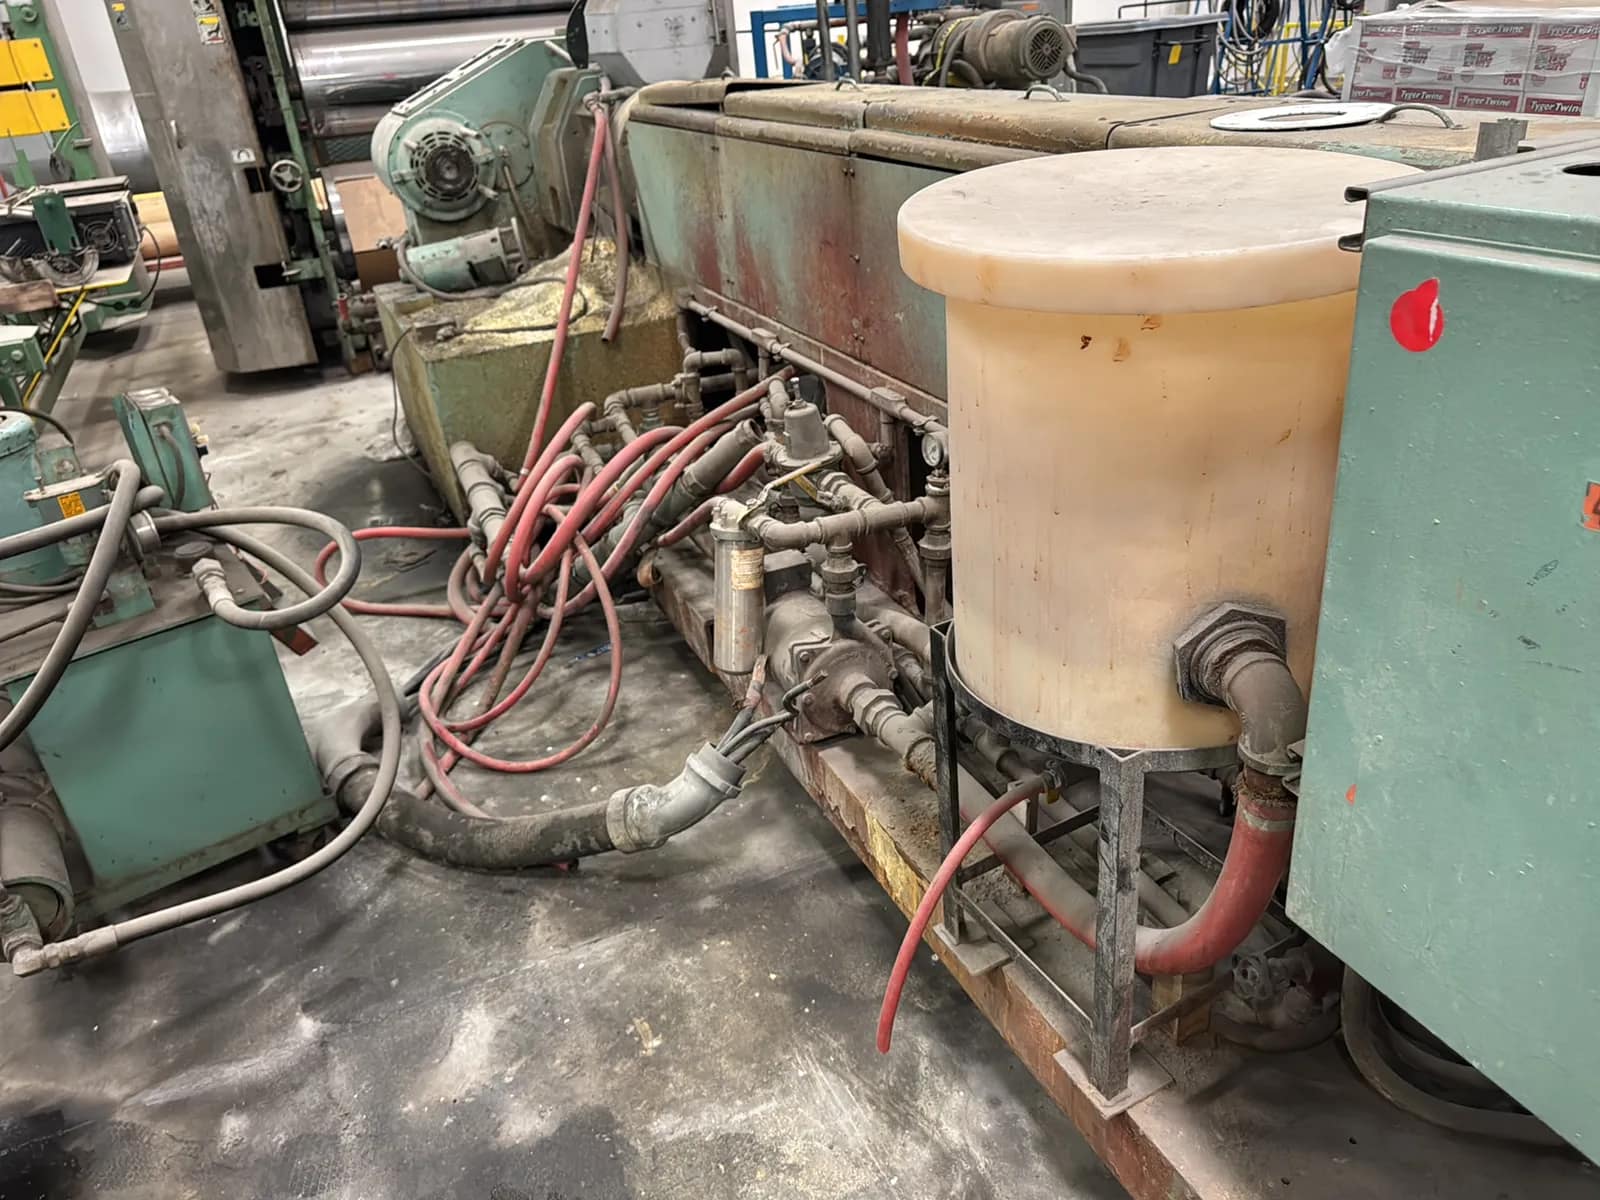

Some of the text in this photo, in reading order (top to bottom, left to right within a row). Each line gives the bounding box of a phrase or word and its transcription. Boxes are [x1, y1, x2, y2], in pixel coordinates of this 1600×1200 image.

[1463, 95, 1511, 107] Tyger Twine
[1531, 100, 1555, 113] Tyger
